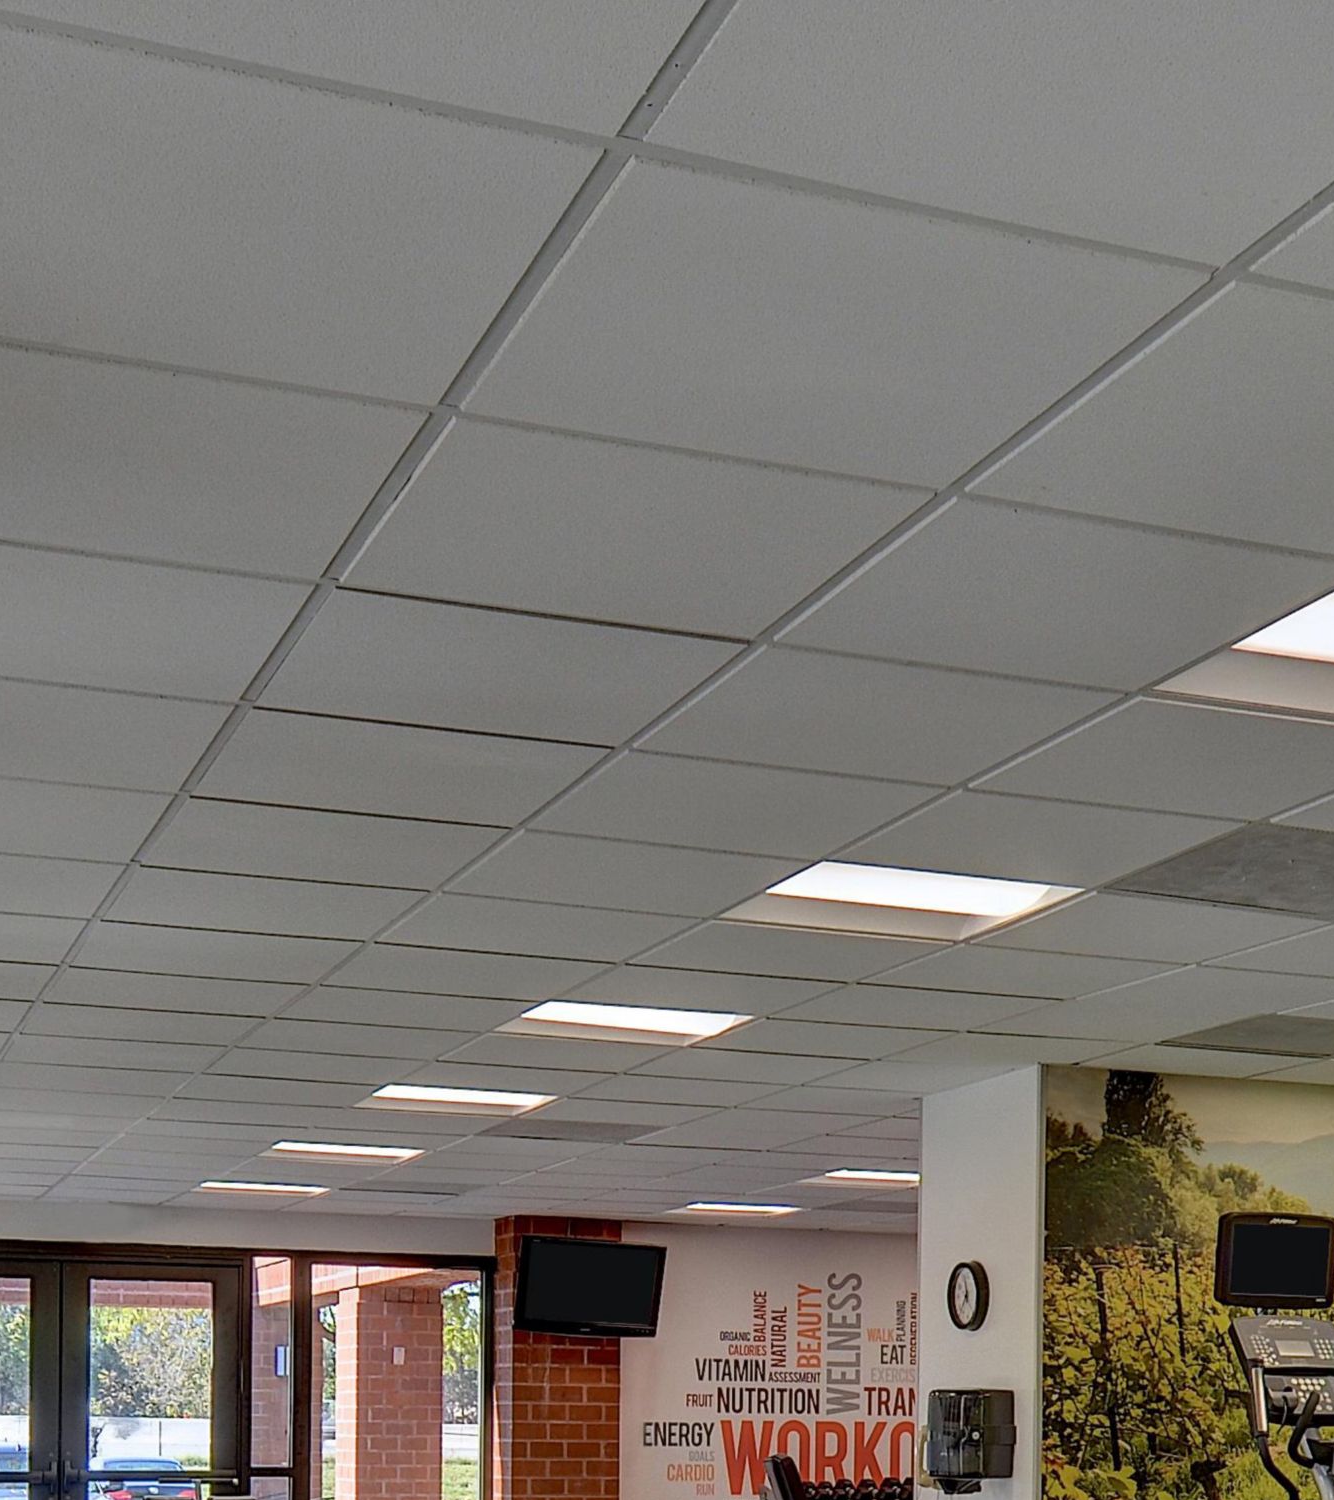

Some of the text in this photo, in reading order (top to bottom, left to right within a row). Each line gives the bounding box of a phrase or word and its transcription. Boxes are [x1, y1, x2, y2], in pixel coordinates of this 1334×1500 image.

[752, 1290, 767, 1342] BALANCE
[795, 1283, 822, 1369] BEAUTY
[895, 1300, 907, 1342] PLANNING
[719, 1330, 751, 1342] ORGANIC
[771, 1306, 787, 1368] NATURAL
[826, 1272, 863, 1416] WELNESS
[866, 1327, 895, 1342] WALK
[728, 1344, 767, 1356] CALORIES
[880, 1344, 906, 1365] EAT
[695, 1358, 766, 1382] VITAMIN
[768, 1371, 821, 1384] ASSESSMENT
[685, 1393, 714, 1408] FRUIT
[717, 1387, 820, 1415] NUTRITION
[642, 1421, 715, 1447] ENERGY
[666, 1463, 715, 1482] CARDIO
[695, 1483, 715, 1496] RUN
